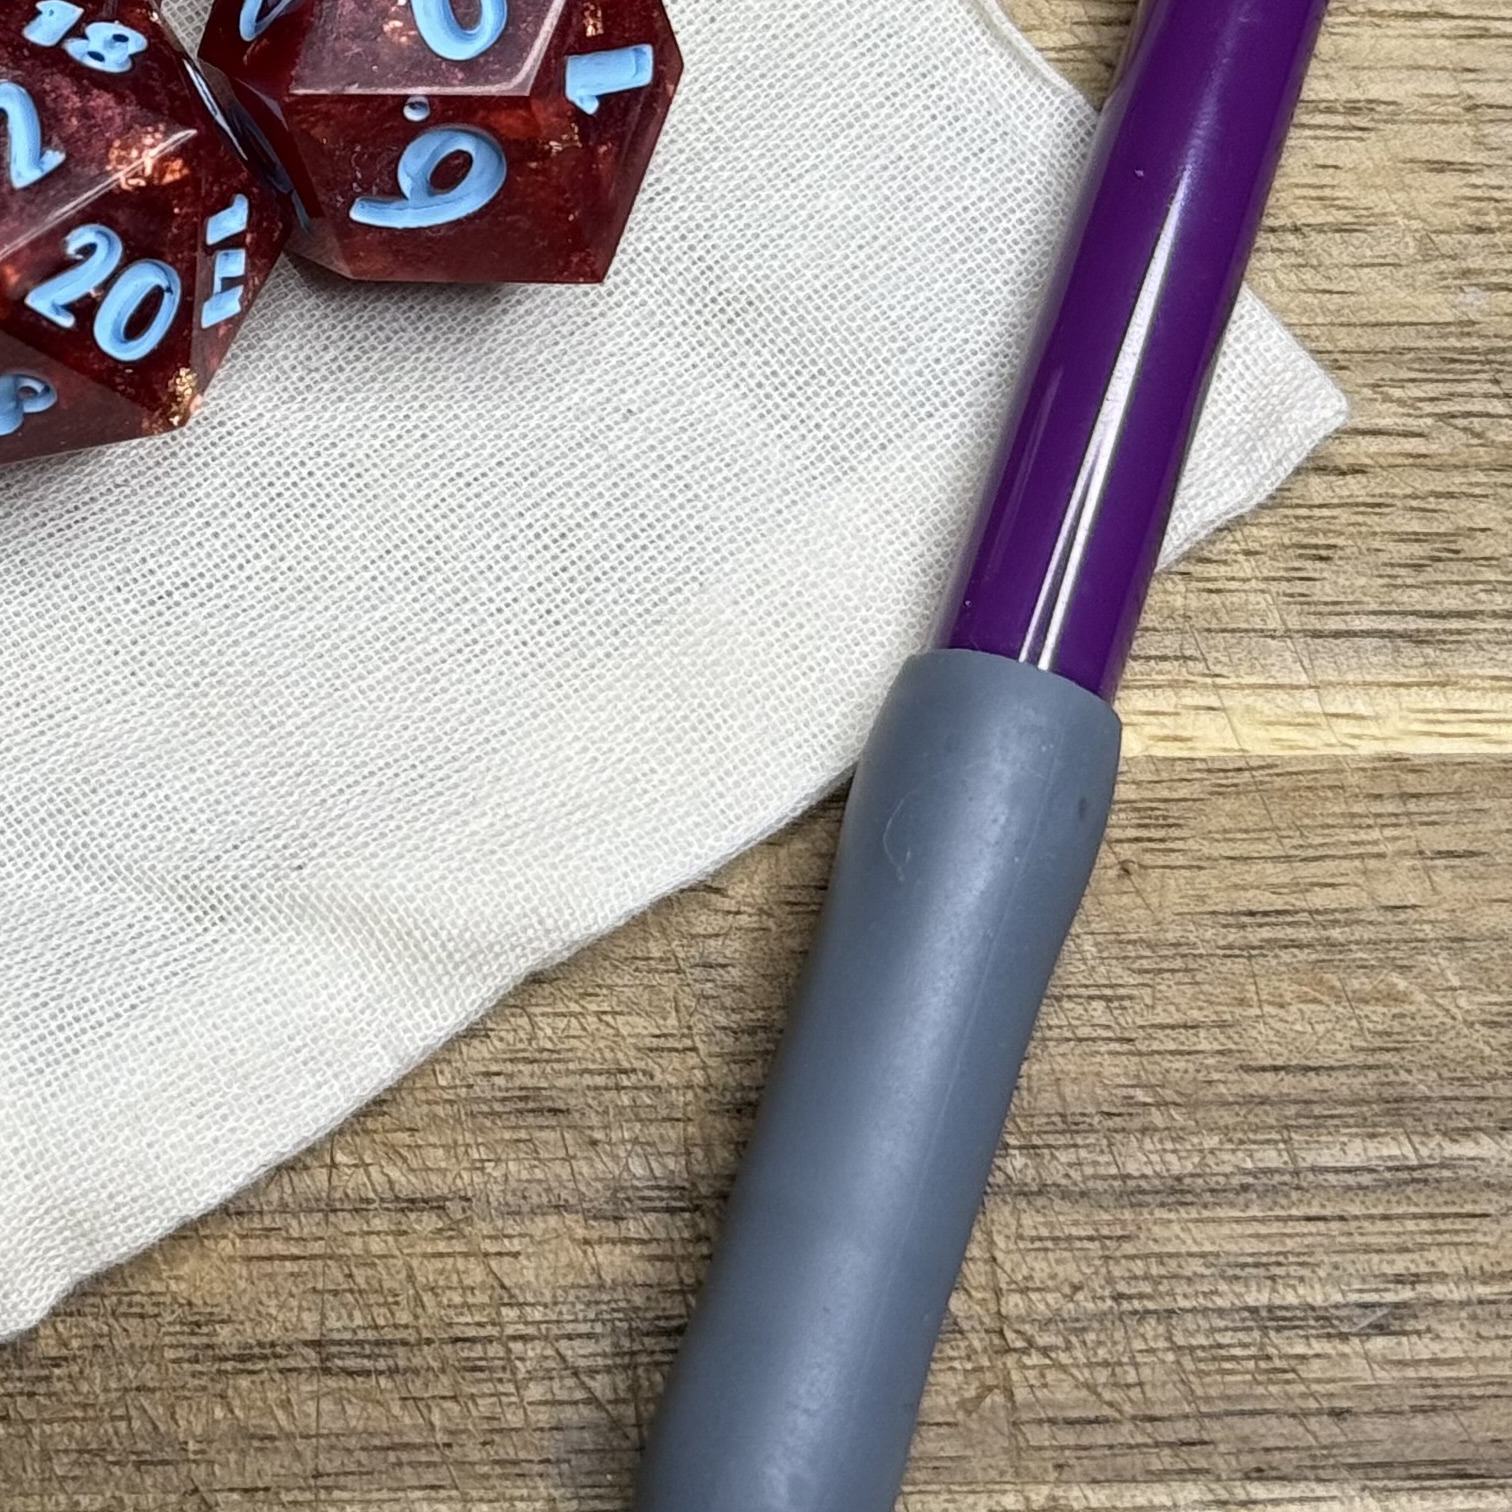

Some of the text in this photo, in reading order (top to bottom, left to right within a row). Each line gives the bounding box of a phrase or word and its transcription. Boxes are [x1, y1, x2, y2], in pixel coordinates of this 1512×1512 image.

[23, 0, 148, 73] 18
[565, 44, 654, 116] 1
[25, 223, 182, 362] 20
